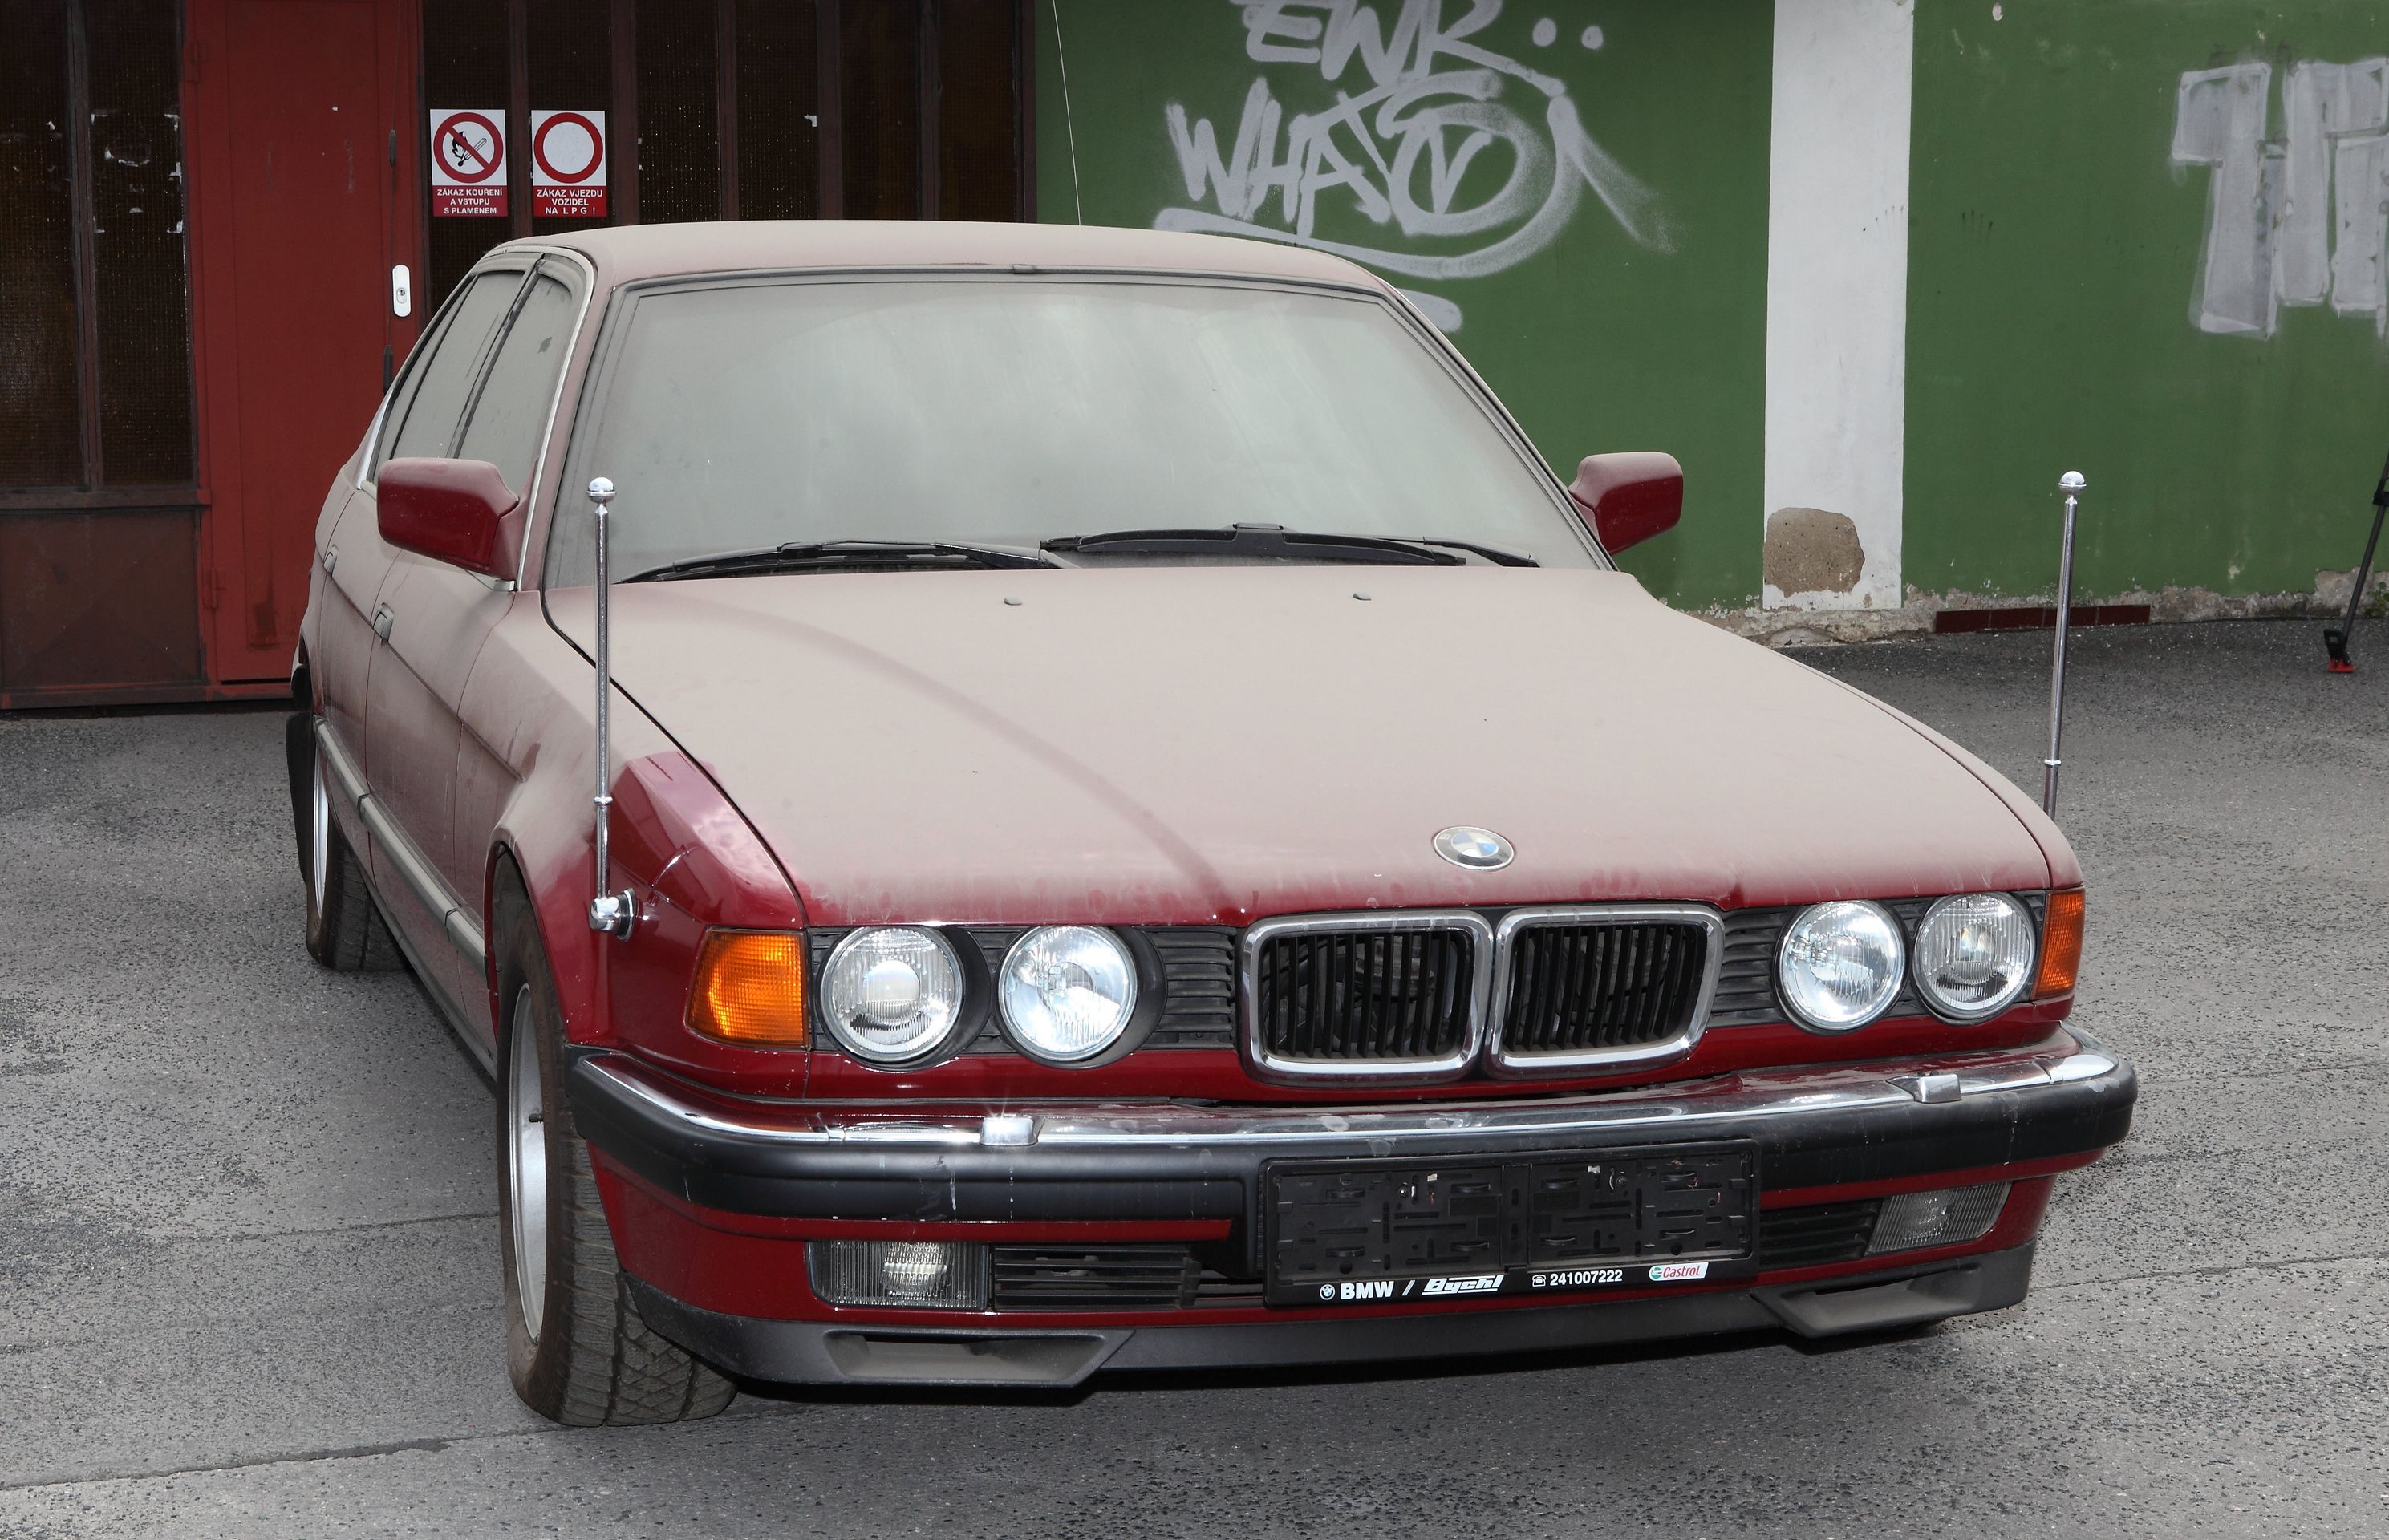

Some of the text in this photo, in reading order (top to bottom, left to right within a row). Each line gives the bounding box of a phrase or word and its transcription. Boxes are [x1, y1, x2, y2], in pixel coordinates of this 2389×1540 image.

[436, 188, 503, 196] ZÁKAZ KOUŘENÍ
[537, 188, 603, 197] ZÁKAZ VJEZDU
[551, 198, 589, 206] VOZIDEL
[1549, 1269, 1624, 1286] 241007222
[1663, 1264, 1701, 1279] Castrol
[1340, 1280, 1395, 1300] BMW
